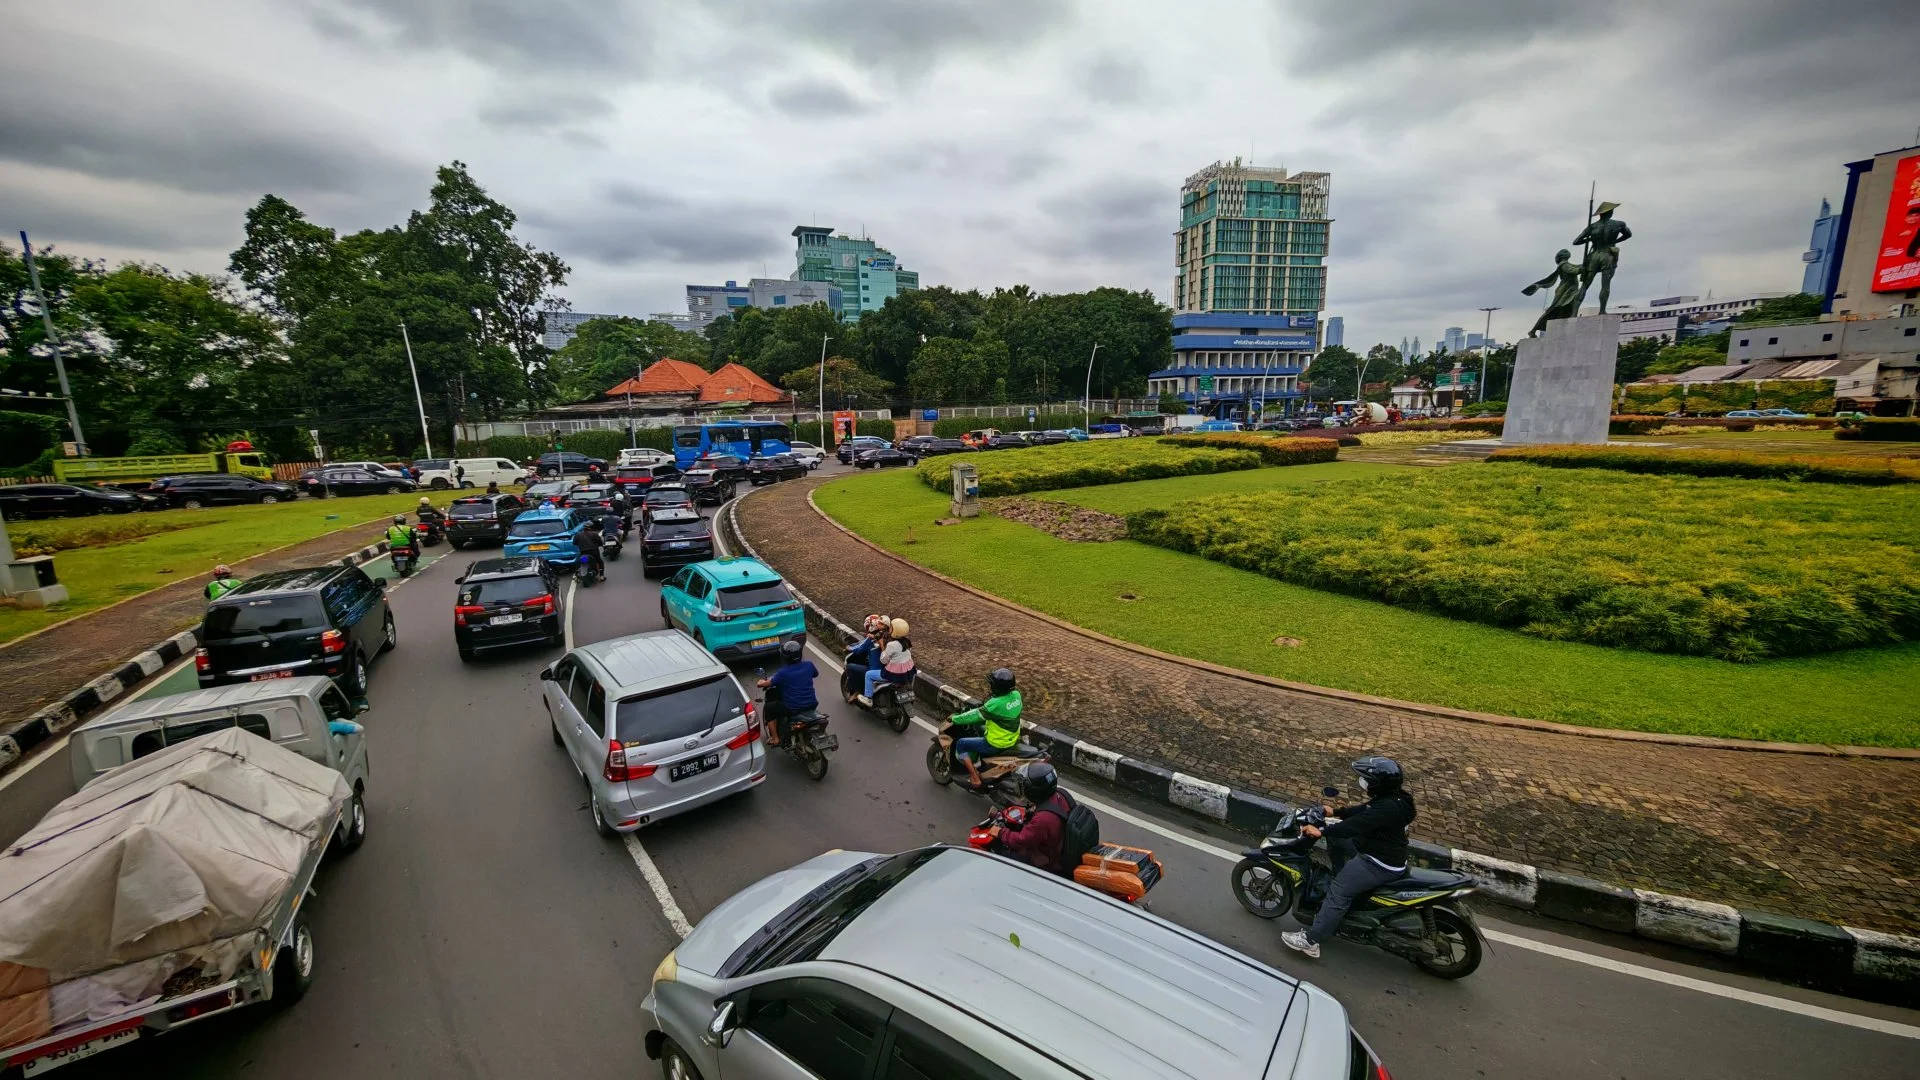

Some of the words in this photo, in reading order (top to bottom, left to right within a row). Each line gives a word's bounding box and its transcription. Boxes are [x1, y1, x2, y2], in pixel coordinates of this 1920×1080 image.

[1006, 699, 1020, 710] Grab
[672, 768, 678, 777] B
[681, 762, 699, 774] 2892
[703, 755, 718, 767] KMB
